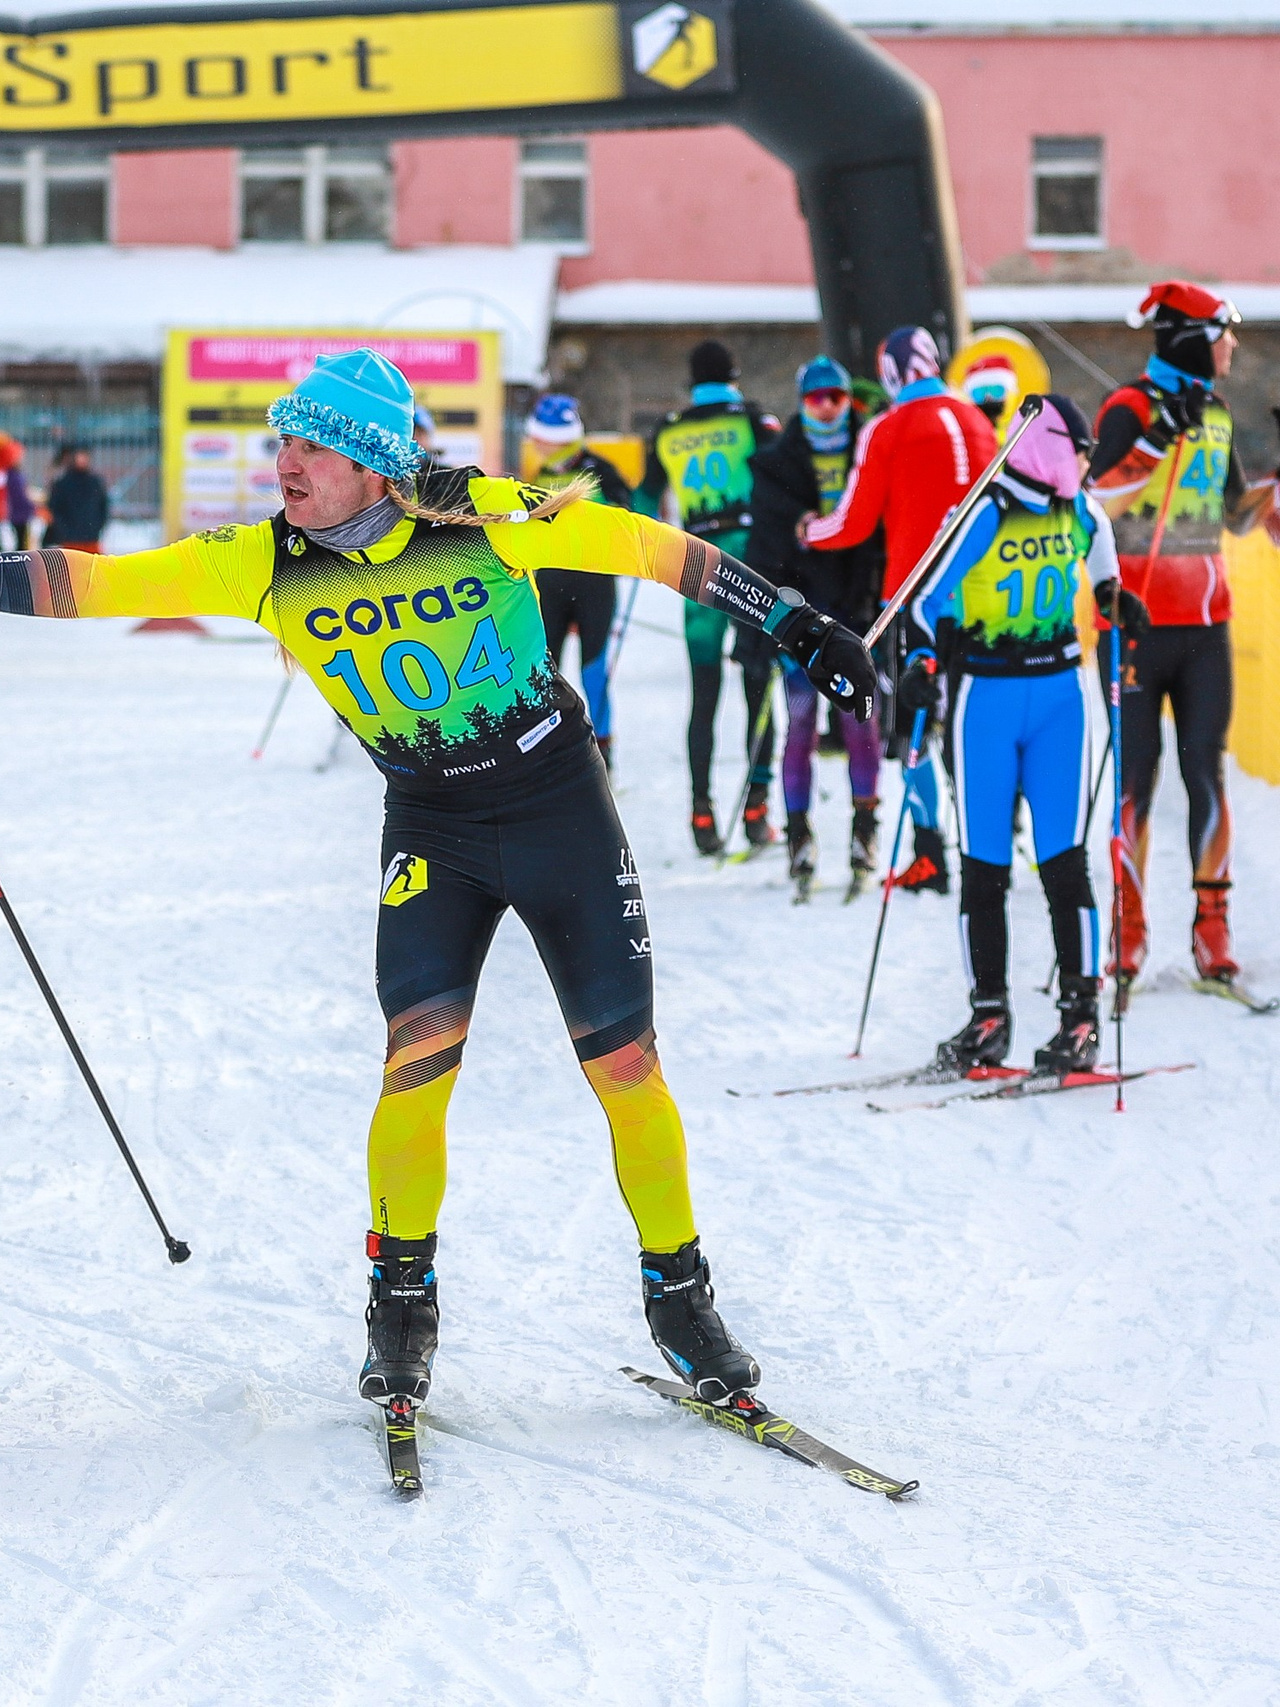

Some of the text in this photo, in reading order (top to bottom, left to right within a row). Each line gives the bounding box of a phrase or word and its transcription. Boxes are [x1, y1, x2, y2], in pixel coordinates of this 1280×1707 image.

[682, 451, 729, 492] 40
[304, 576, 490, 642] согаз
[705, 579, 767, 623] MARATHON TEAM
[321, 614, 515, 716] 104
[443, 757, 498, 778] DIWARI
